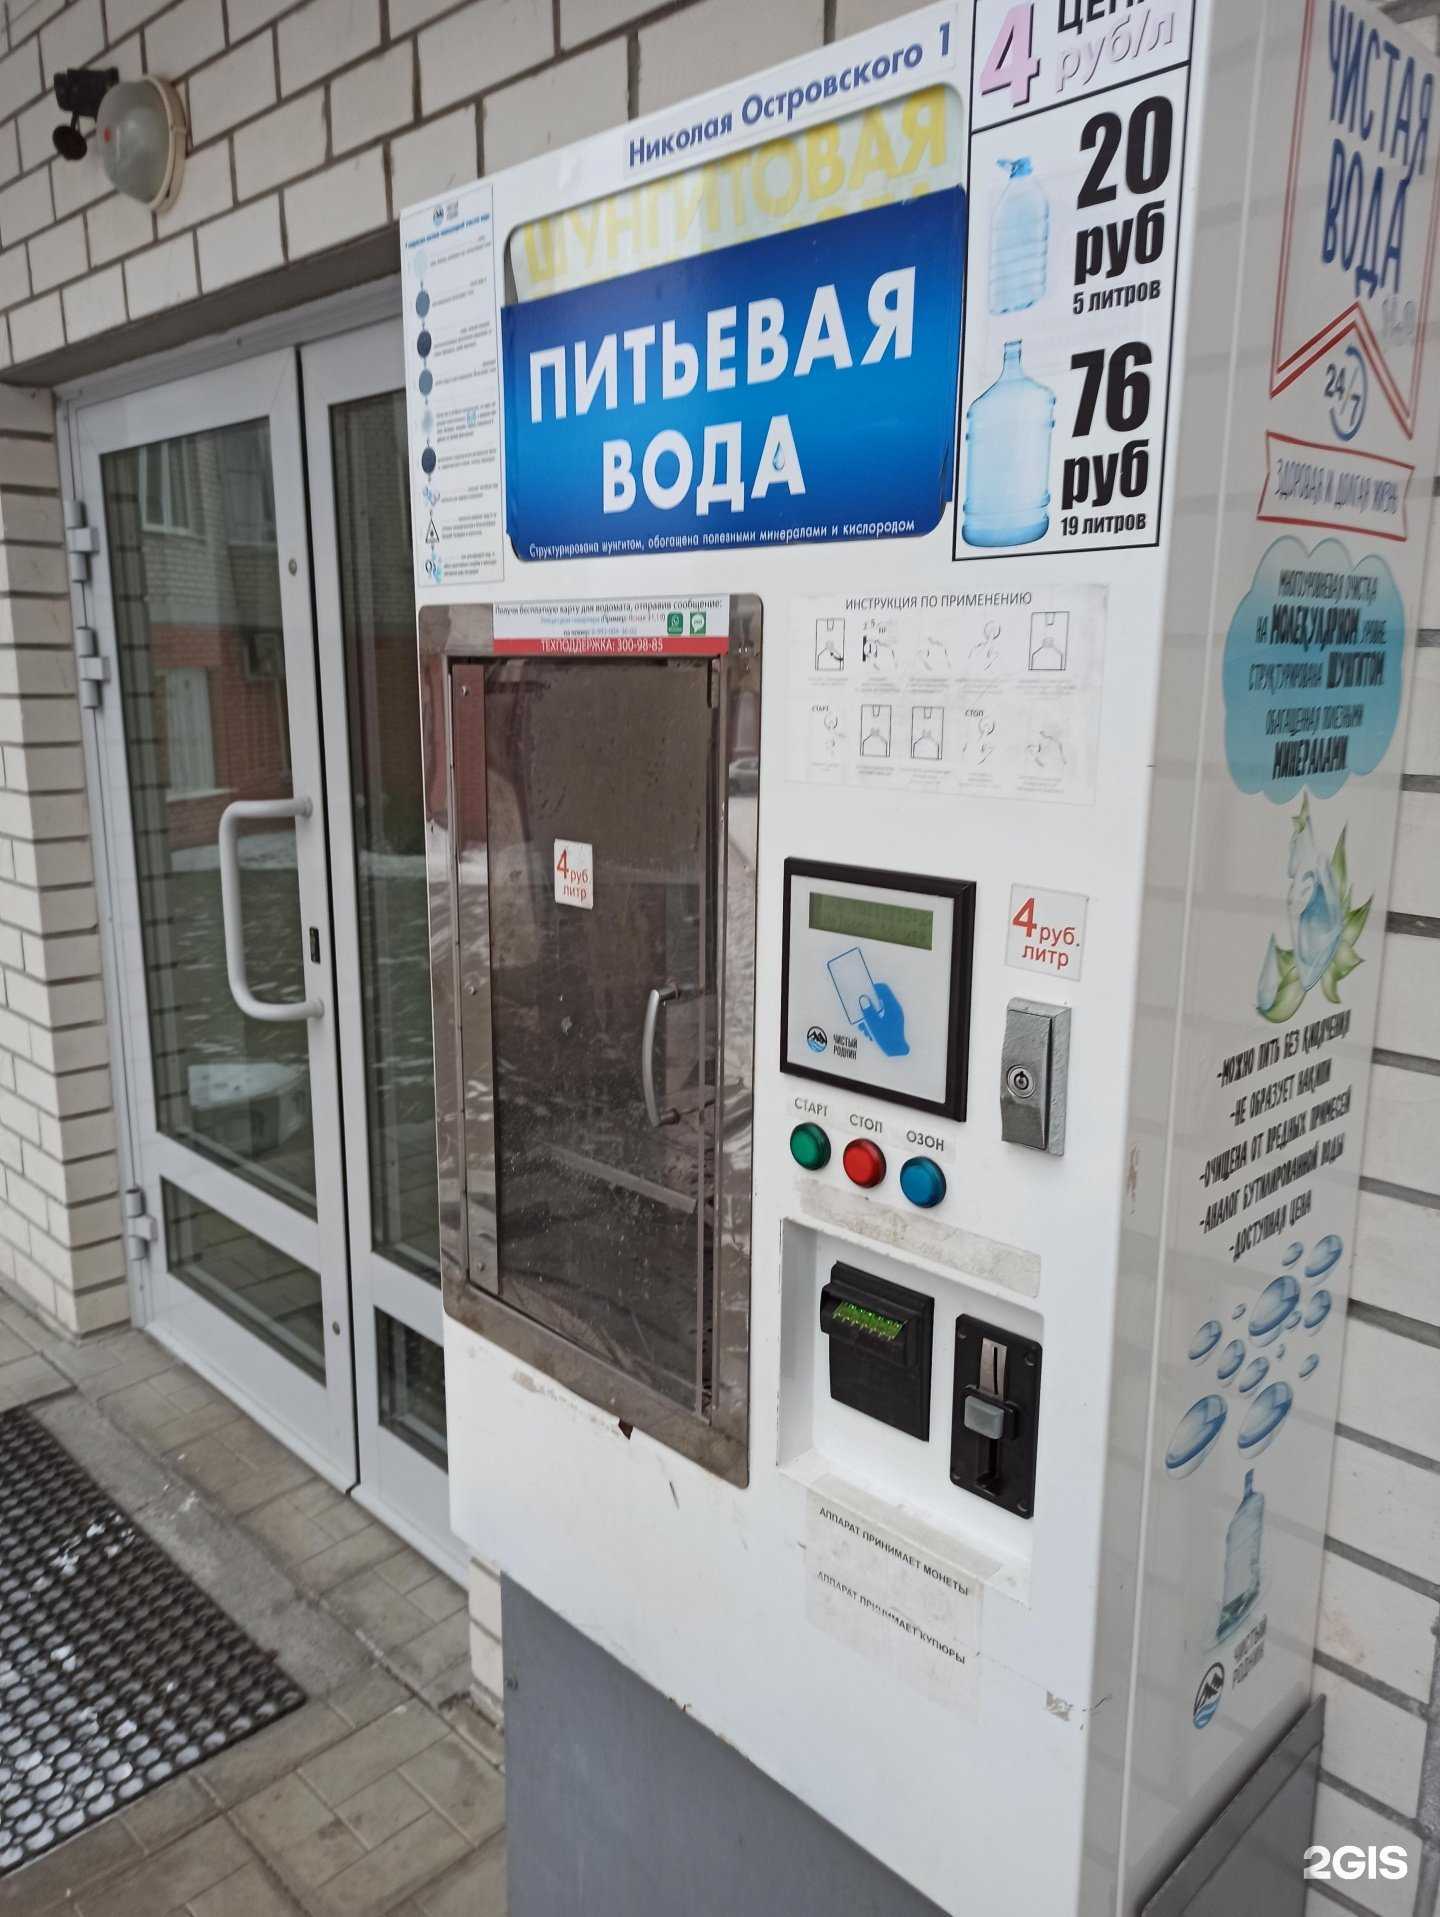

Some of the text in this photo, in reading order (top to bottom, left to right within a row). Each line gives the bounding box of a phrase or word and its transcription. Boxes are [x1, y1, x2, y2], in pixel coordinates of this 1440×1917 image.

[980, 3, 1040, 107] 4
[1056, 8, 1175, 93] руб/л
[628, 22, 951, 168] Николая Островского 1
[1328, 0, 1434, 180] ЧИСТАЯ
[1077, 95, 1174, 210] 20
[1073, 200, 1167, 285] руб
[1322, 138, 1407, 299] ВОДА
[1073, 280, 1161, 315] 5 литров
[530, 266, 916, 424] ПИТЬЕВАЯ
[1070, 341, 1153, 438] 76
[602, 415, 806, 515] ВОДА
[1062, 439, 1149, 510] руб
[529, 519, 915, 560] Структурирована шунгитом, обогащена полезными минералами и кислородом
[1060, 513, 1147, 537] 19 литров
[845, 591, 1032, 611] ИНСТРУКЦИЯ ПО ПРИМЕНЕНИЮ
[617, 637, 663, 653] 300-98-85
[557, 849, 588, 885] 4 руб
[563, 885, 587, 903] литр
[1012, 897, 1080, 949] 4 руб.
[1022, 944, 1070, 970] литр
[1256, 1037, 1280, 1072] ПИТЬ
[1283, 1028, 1300, 1060] БЕЗ
[794, 1097, 829, 1117] СТАРТ
[1249, 1073, 1296, 1119] ОБРАЗУЕТ
[849, 1113, 883, 1134] СТОП
[906, 1130, 945, 1153] ОЗОН
[1250, 1132, 1265, 1163] ОТ
[820, 1506, 969, 1597] АППАРАТ ПРИНИМАЕТ МОНЕТЫ
[817, 1570, 858, 1600] АППАРАТ
[919, 1627, 966, 1665] КУПЮРЫ
